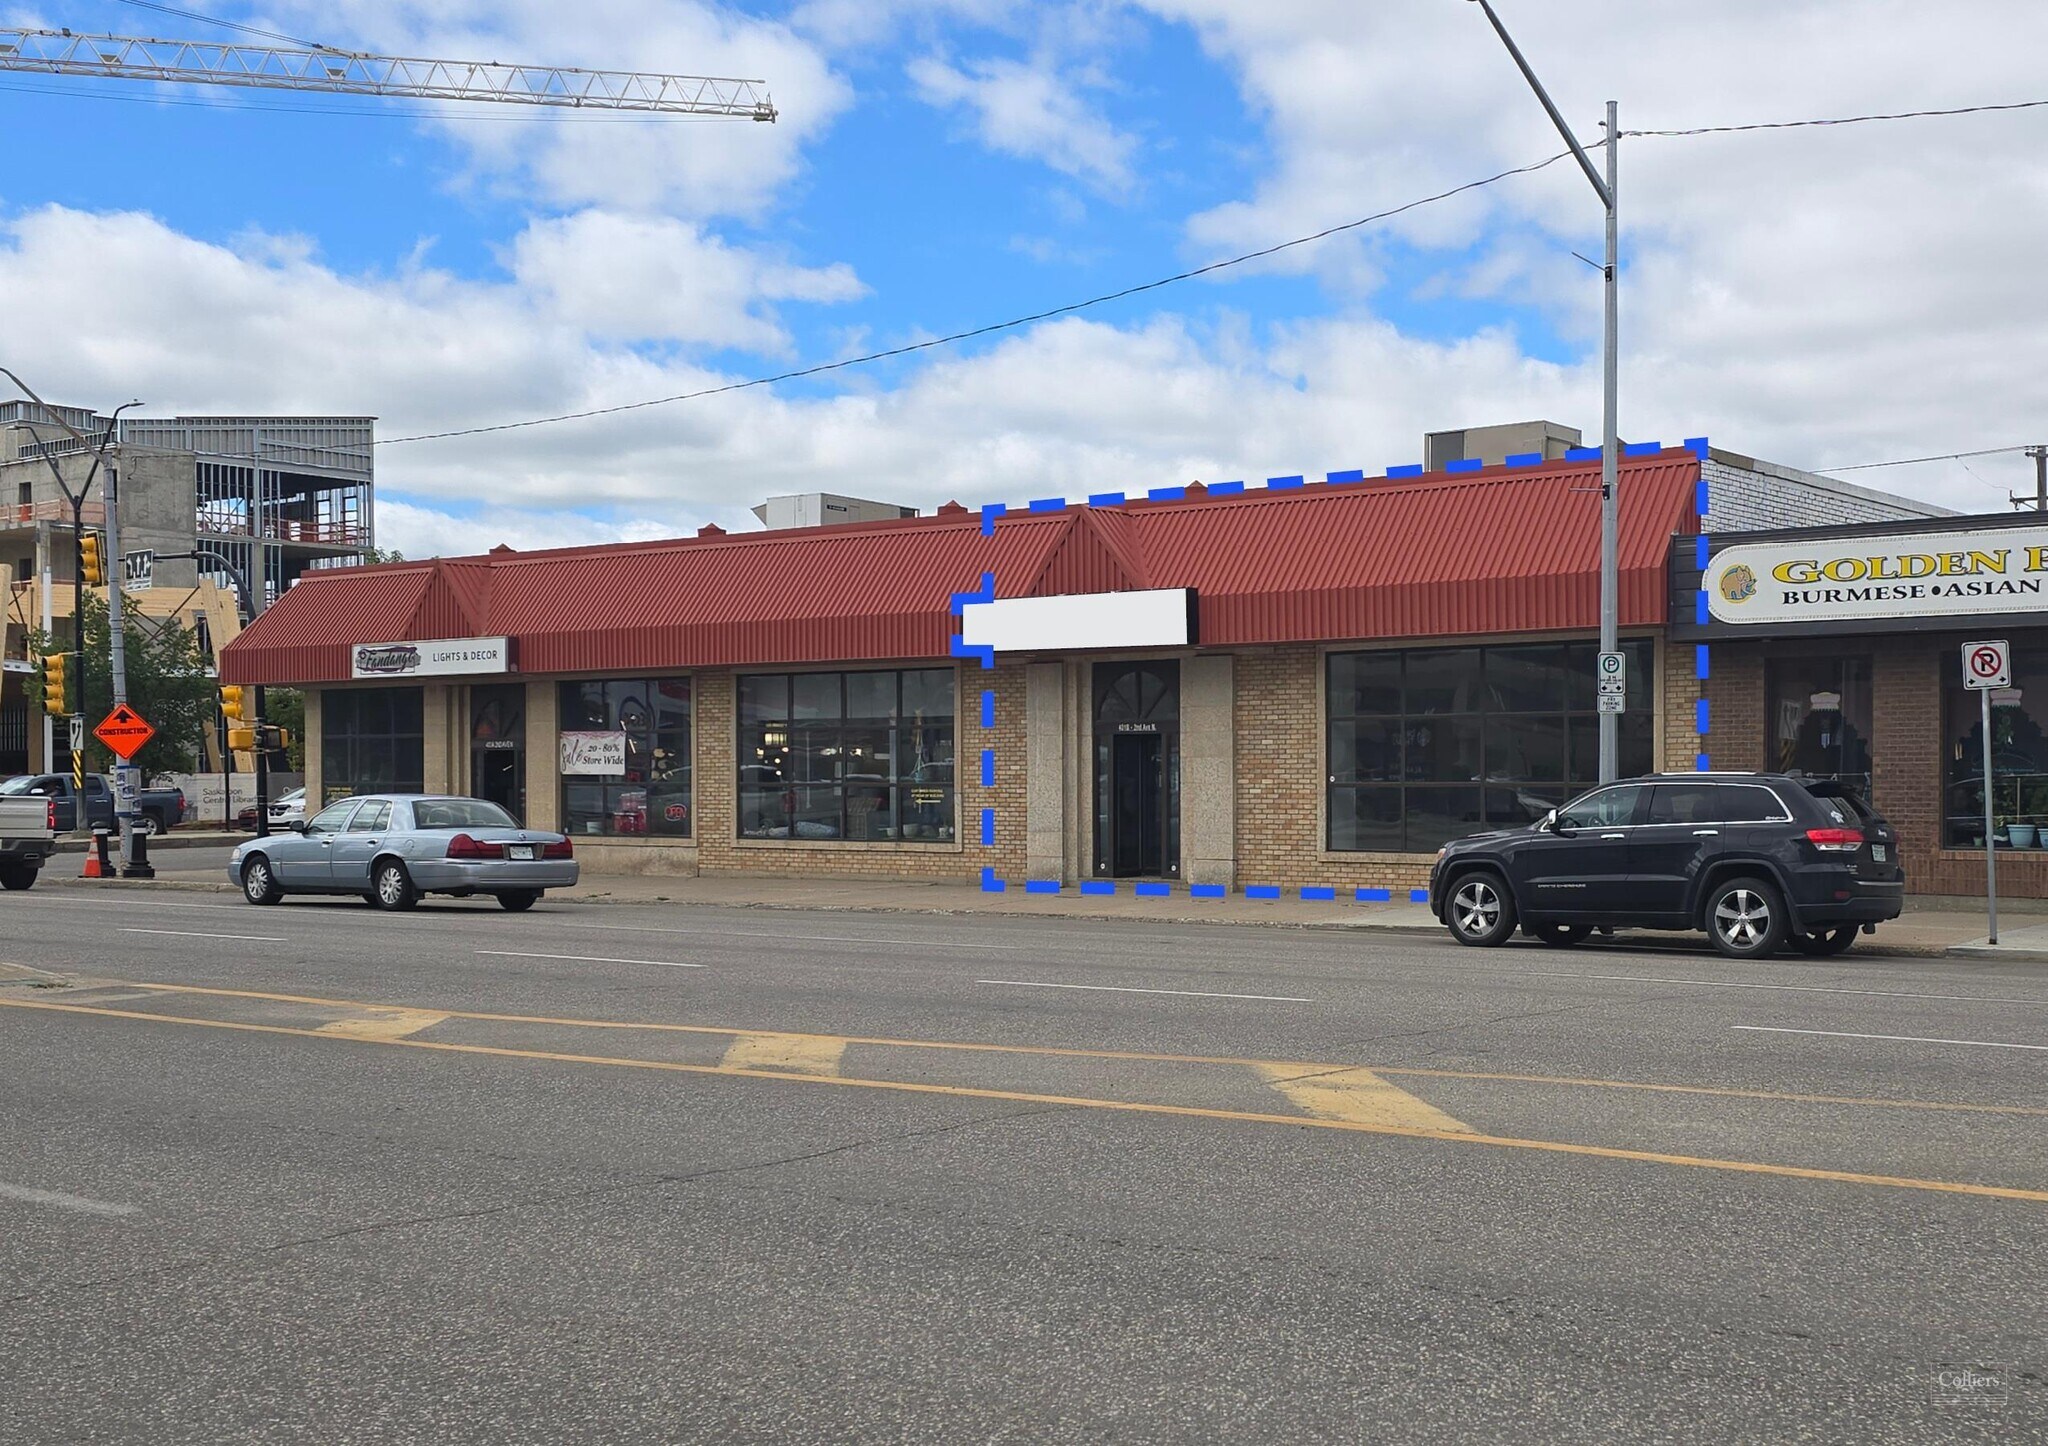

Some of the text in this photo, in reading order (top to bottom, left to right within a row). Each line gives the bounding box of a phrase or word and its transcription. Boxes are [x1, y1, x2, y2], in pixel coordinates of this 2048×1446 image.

[1772, 549, 2011, 585] GOLDEN
[1782, 578, 2042, 605] BURMESE ASIAN
[365, 649, 417, 672] Fandango
[433, 650, 498, 662] LIGHTS & DECOR
[99, 727, 148, 736] CONSTRUCTION
[561, 739, 583, 772] Sale
[602, 743, 620, 753] 80%
[582, 755, 624, 765] Store Wide
